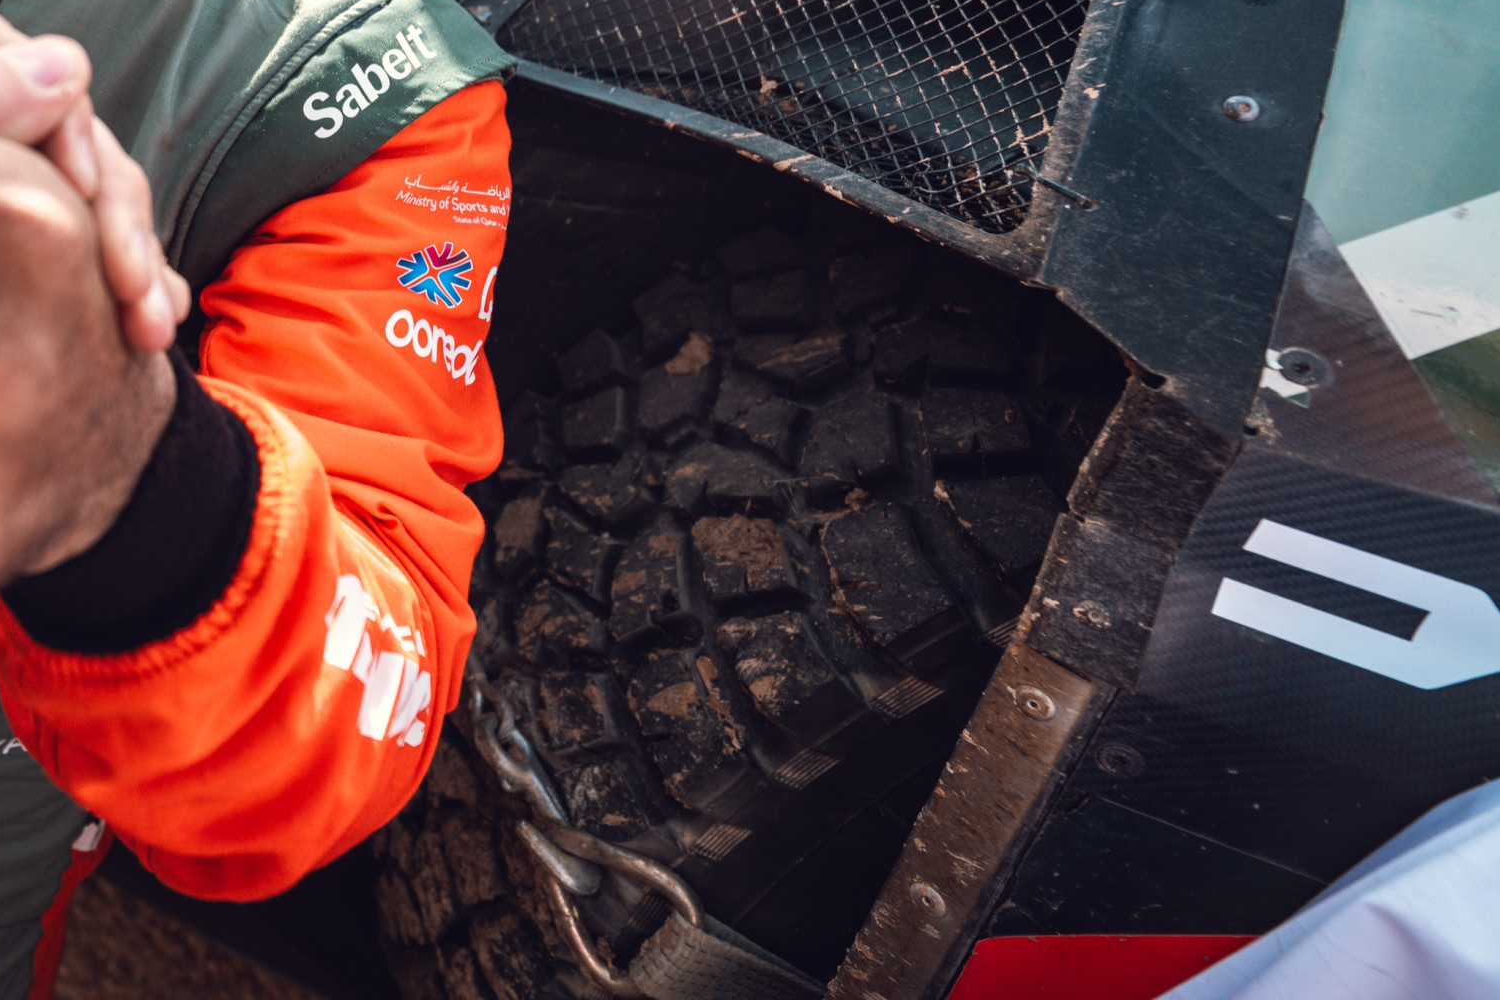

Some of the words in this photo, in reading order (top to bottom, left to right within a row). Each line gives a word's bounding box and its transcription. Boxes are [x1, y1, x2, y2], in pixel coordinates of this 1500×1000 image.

[303, 24, 437, 139] Sabelt
[395, 190, 437, 212] Ministry
[439, 196, 450, 209] of
[451, 197, 488, 213] Sports
[490, 203, 506, 216] and
[453, 215, 472, 224] State
[481, 216, 498, 227] Qatar
